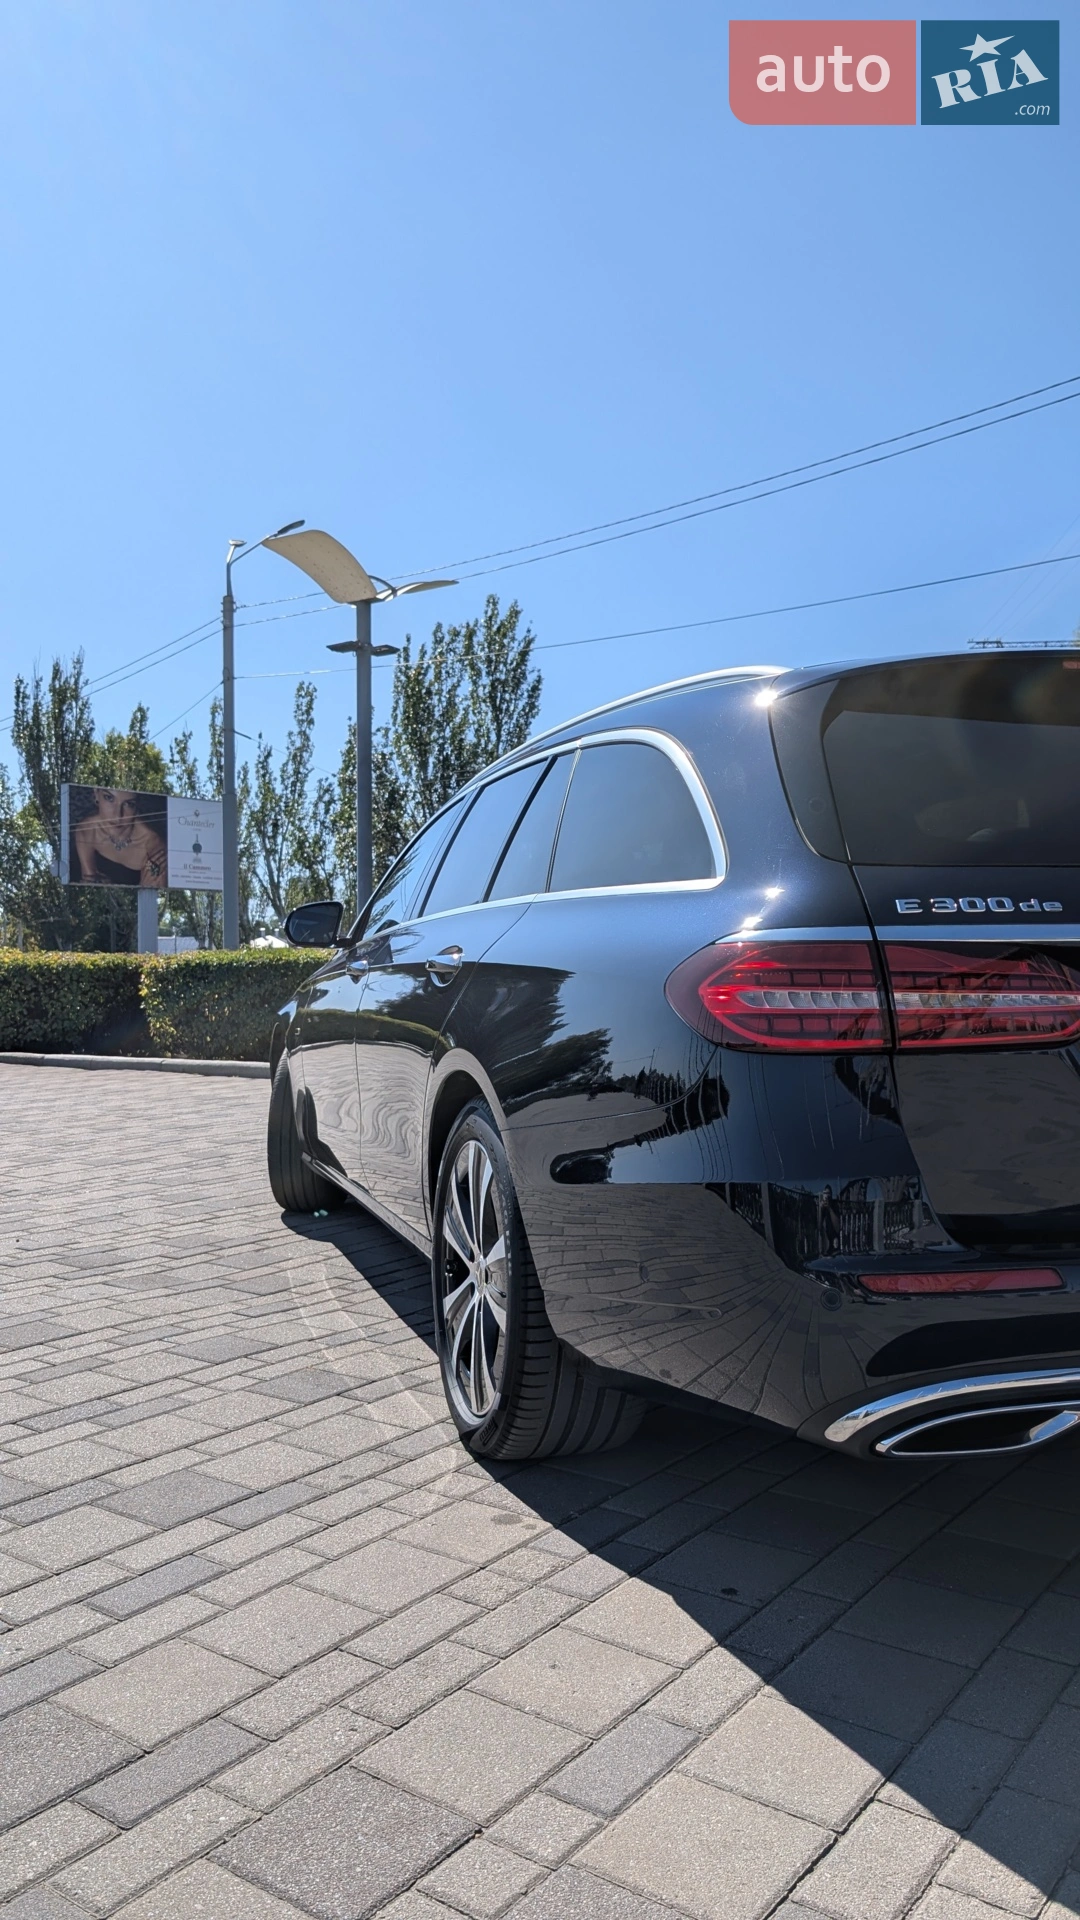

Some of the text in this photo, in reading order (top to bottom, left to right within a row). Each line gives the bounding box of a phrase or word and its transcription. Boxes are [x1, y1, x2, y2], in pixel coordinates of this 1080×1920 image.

[895, 896, 1063, 914] E 300 de
